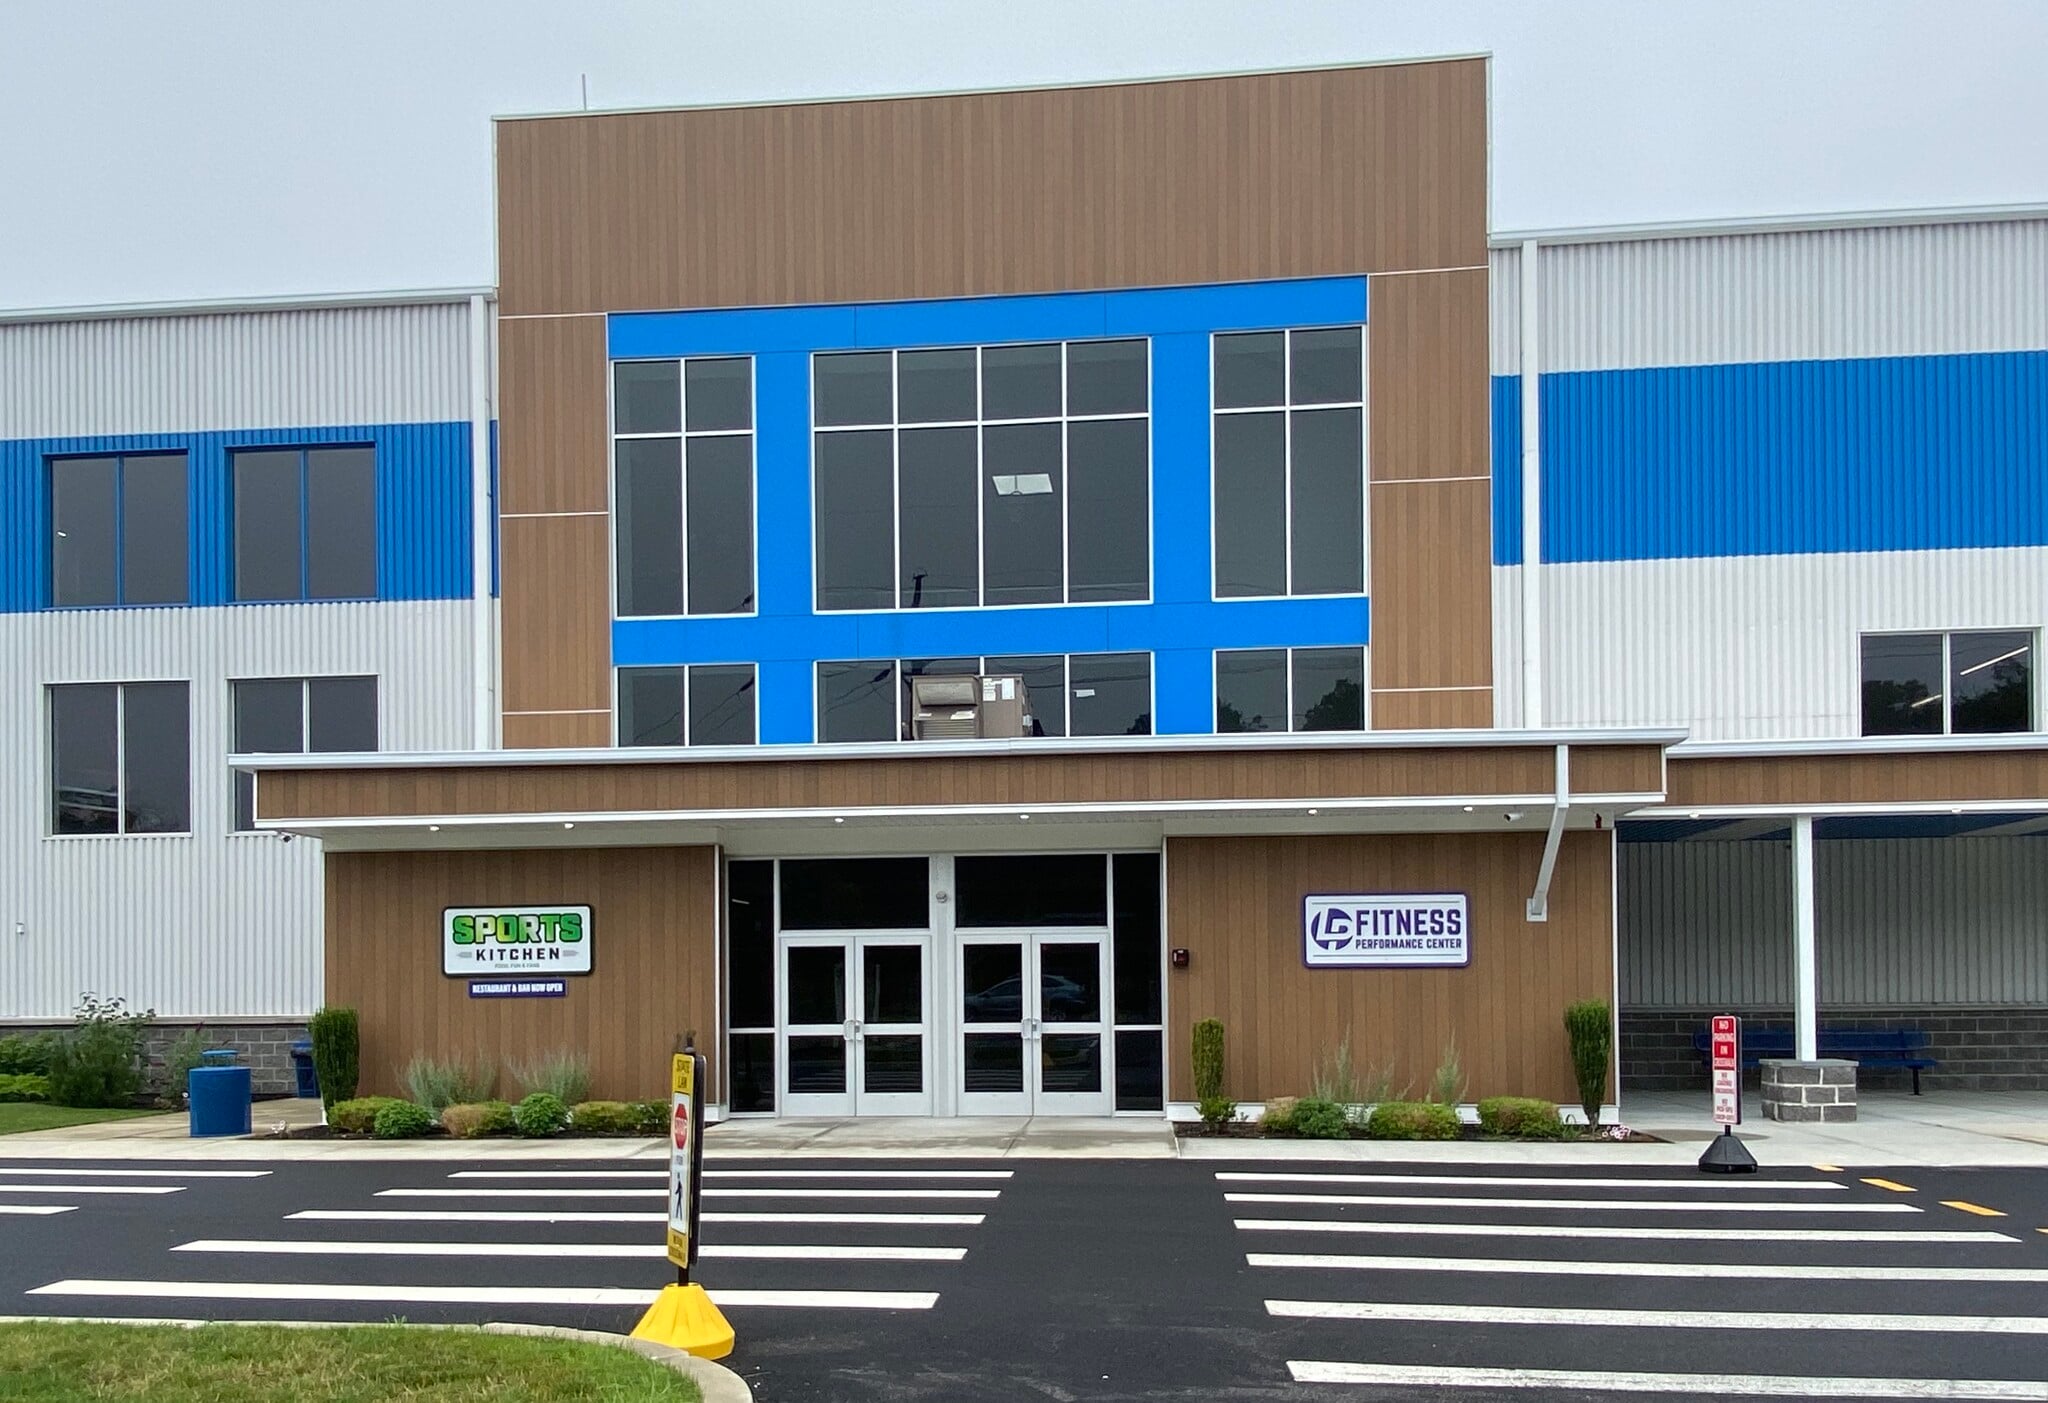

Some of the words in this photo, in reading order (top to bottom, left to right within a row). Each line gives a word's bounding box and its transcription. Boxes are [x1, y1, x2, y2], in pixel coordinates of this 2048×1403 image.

[452, 913, 583, 945] SPORTS
[1356, 908, 1461, 936] FITNESS
[1355, 938, 1424, 950] PERFORMANCE
[1426, 938, 1462, 949] CENTER
[476, 947, 560, 961] KITCHEN
[472, 984, 512, 993] RESTAURANT
[512, 983, 518, 993] &
[518, 983, 531, 992] BAR
[531, 983, 546, 992] NOW
[546, 982, 563, 992] OPEN
